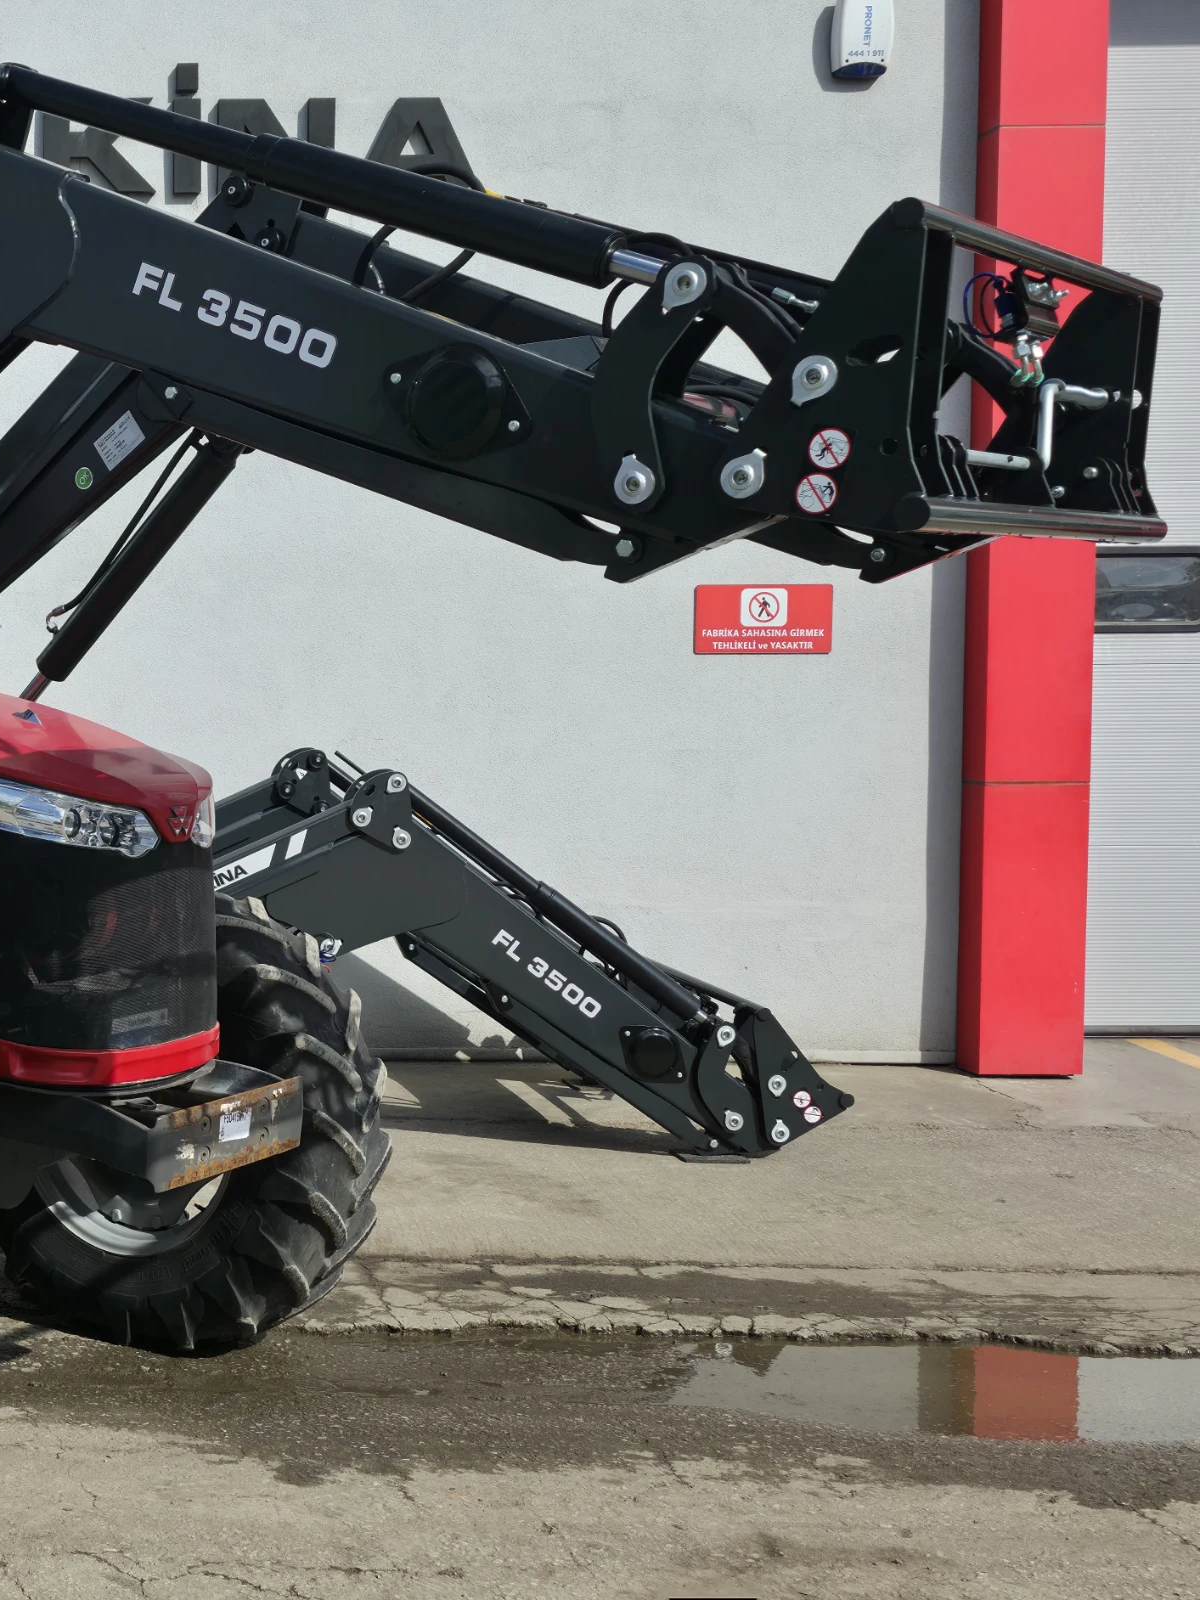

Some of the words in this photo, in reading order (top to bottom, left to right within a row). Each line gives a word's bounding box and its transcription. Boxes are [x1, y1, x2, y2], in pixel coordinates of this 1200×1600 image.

[863, 5, 873, 48] PRONET
[848, 49, 865, 57] 444
[872, 49, 885, 57] 911
[131, 261, 185, 313] FL
[197, 287, 338, 370] 3500
[702, 628, 739, 637] FABRİKA
[742, 629, 788, 637] SAHASINA
[790, 627, 825, 637] GİRMEK
[712, 641, 756, 650] TEHLİKELİ
[770, 641, 813, 650] YASAKTIR
[213, 864, 249, 887] İNA
[490, 928, 522, 963] FL
[526, 955, 603, 1019] 3500
